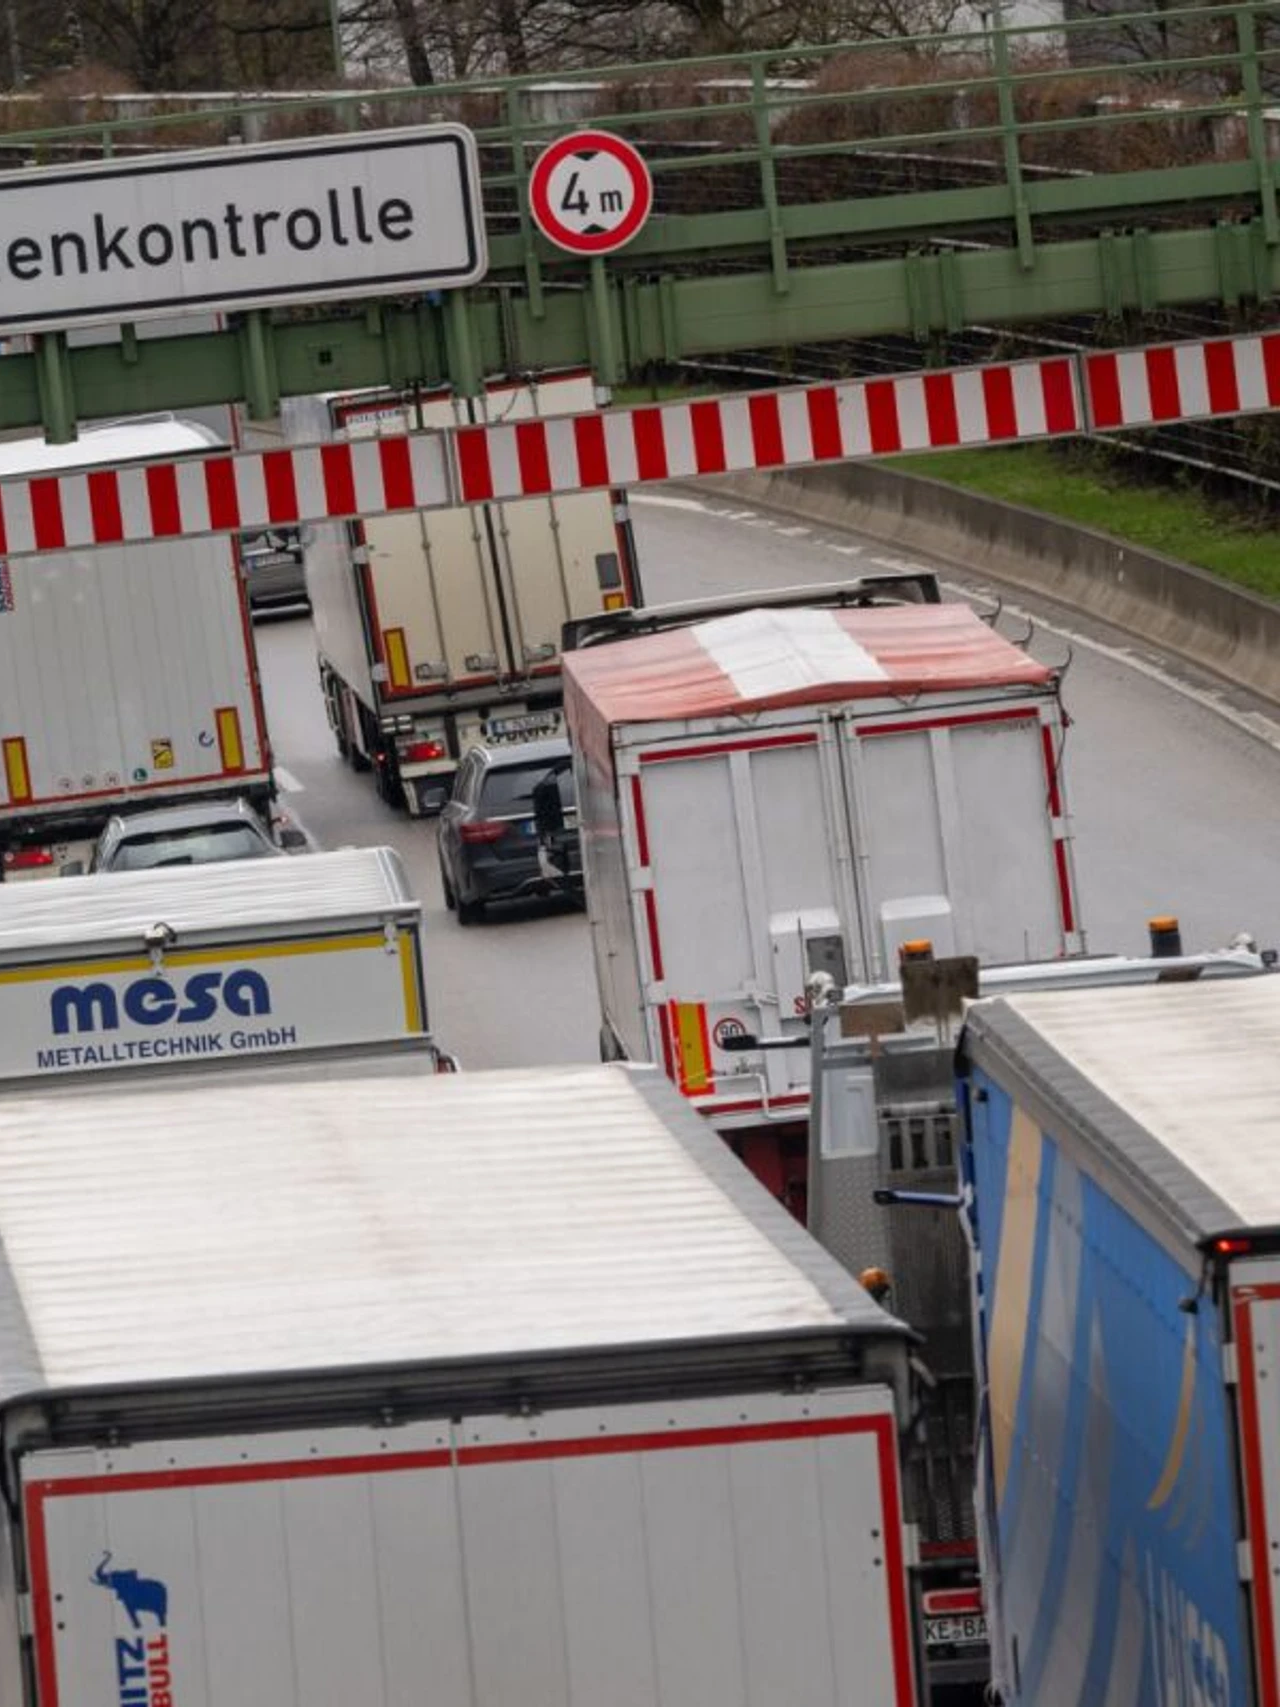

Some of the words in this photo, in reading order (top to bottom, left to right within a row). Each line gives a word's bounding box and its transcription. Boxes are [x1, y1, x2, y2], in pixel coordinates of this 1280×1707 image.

[561, 171, 589, 215] 4
[600, 190, 623, 213] m
[51, 968, 272, 1036] mesa
[37, 1033, 223, 1069] METALLTECHNIK
[230, 1026, 297, 1051] GmbH
[116, 1637, 149, 1707] ITZ
[147, 1634, 172, 1707] BULL
